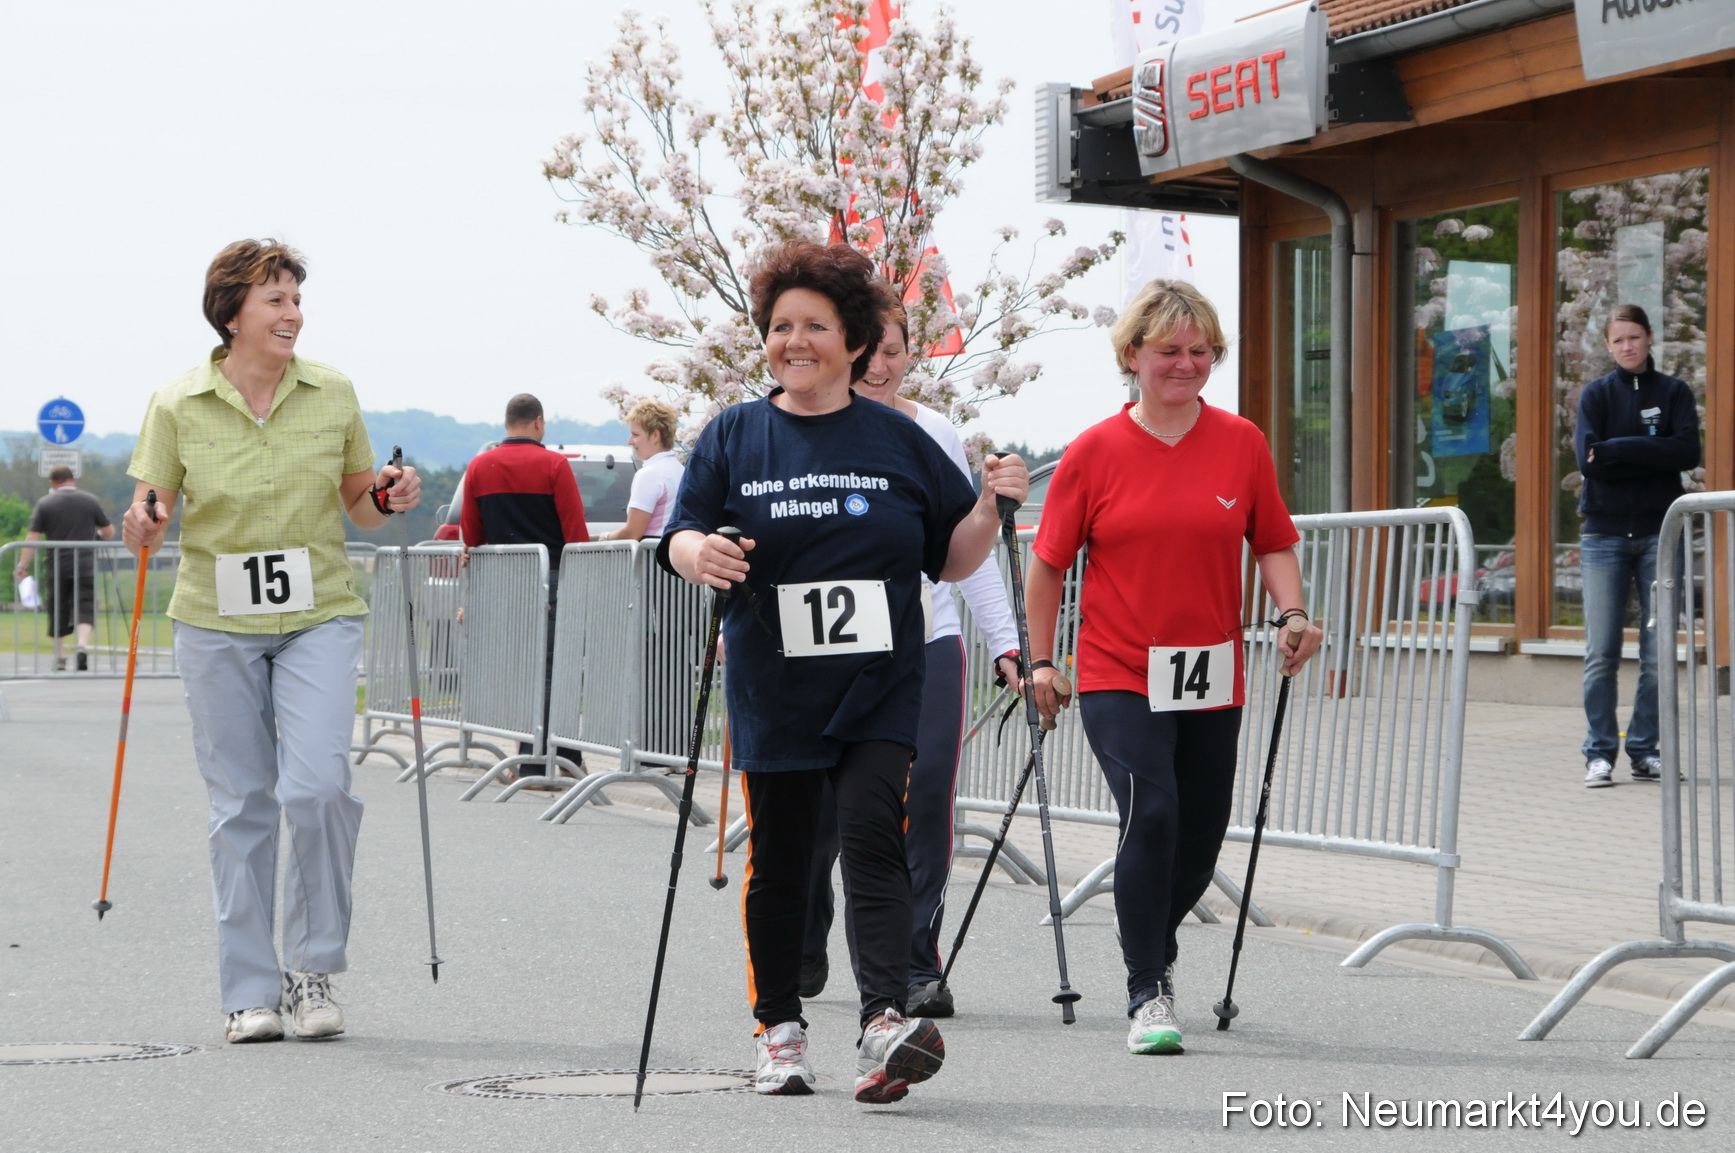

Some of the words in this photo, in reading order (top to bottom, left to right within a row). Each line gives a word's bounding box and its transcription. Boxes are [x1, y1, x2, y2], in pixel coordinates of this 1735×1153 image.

[1187, 49, 1286, 120] SEAT
[741, 480, 785, 497] ohne
[789, 472, 889, 491] erkennbare
[770, 498, 839, 519] Mängel
[243, 554, 291, 605] 15
[803, 586, 858, 645] 12
[1170, 650, 1210, 700] 14
